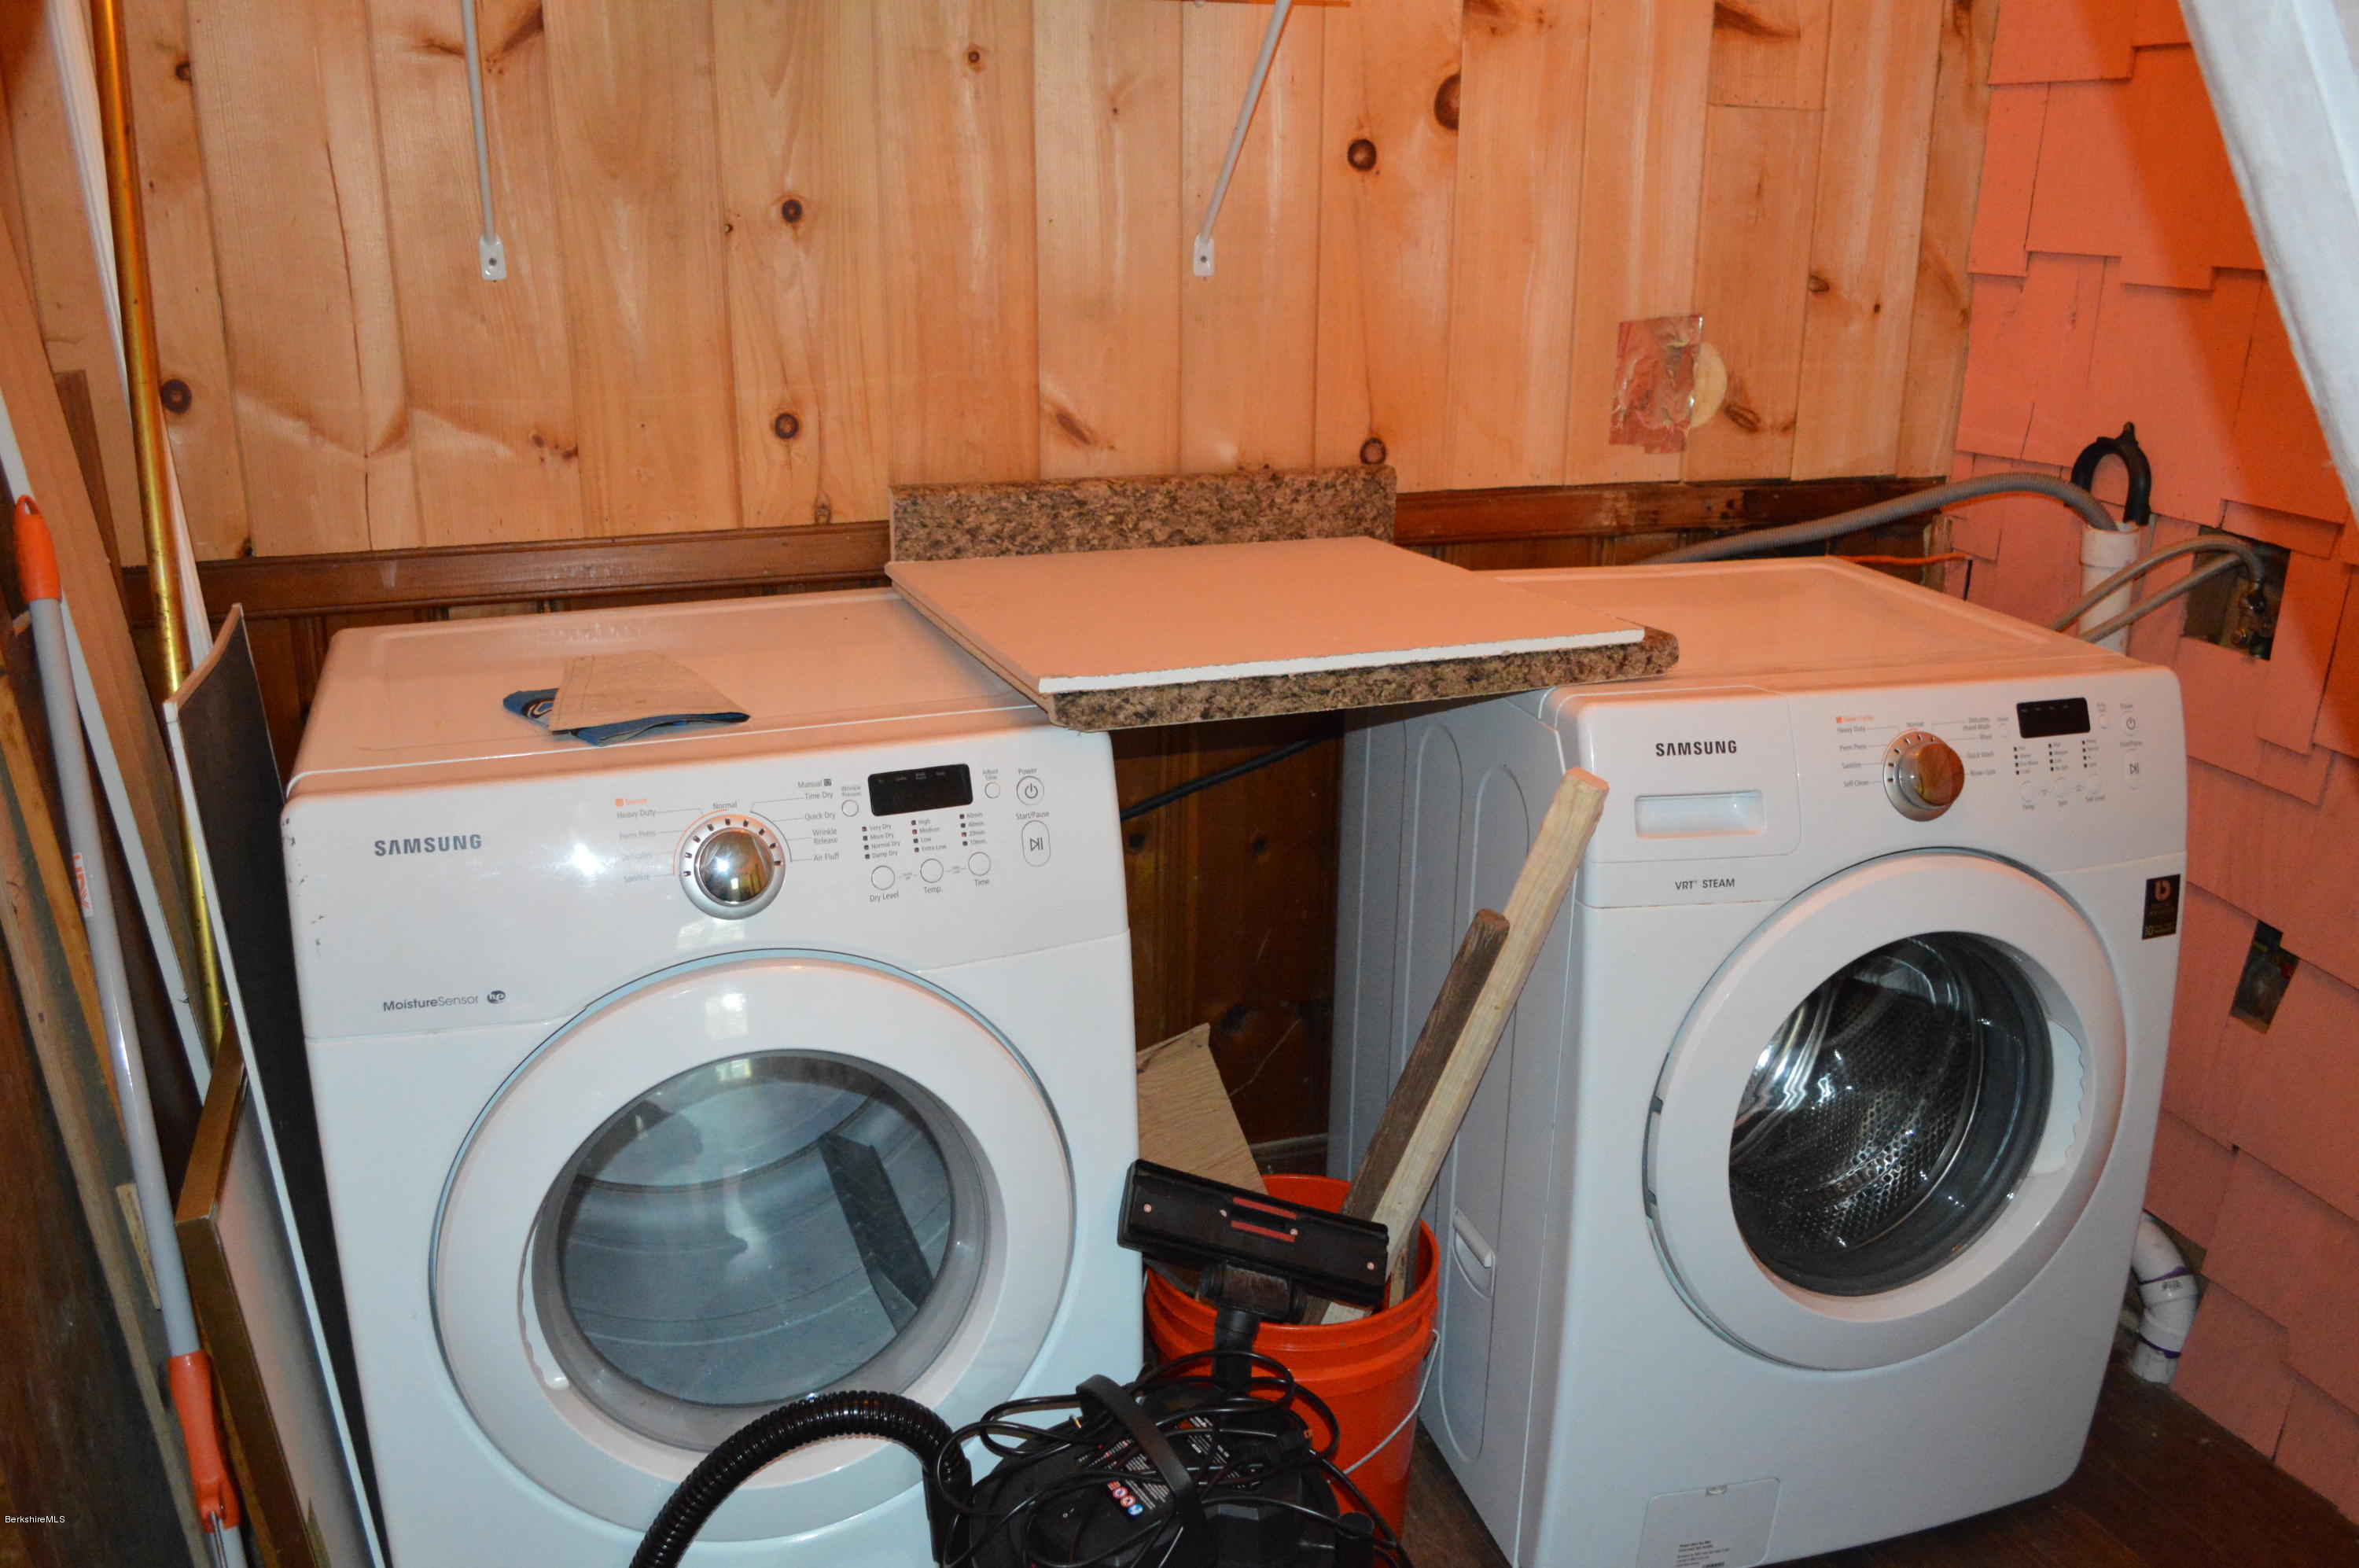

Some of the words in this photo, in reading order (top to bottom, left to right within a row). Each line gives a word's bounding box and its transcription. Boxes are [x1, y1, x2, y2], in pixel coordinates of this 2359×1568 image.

[1655, 740, 1737, 756] SAMSUNG
[712, 801, 738, 810] Normal
[616, 810, 639, 819] Heavy
[639, 808, 657, 817] Duty
[804, 812, 823, 821] Quick
[1015, 811, 1051, 820] Start/Pause
[812, 827, 837, 836] Wrinkle
[620, 832, 638, 841] Perm
[374, 834, 482, 856] SAMSUNG
[824, 852, 840, 860] Fluff
[624, 874, 651, 883] Sanitize
[1702, 878, 1735, 889] STEAM
[870, 894, 881, 903] Dry
[882, 891, 900, 900] Level
[383, 996, 479, 1012] MoistureSensor
